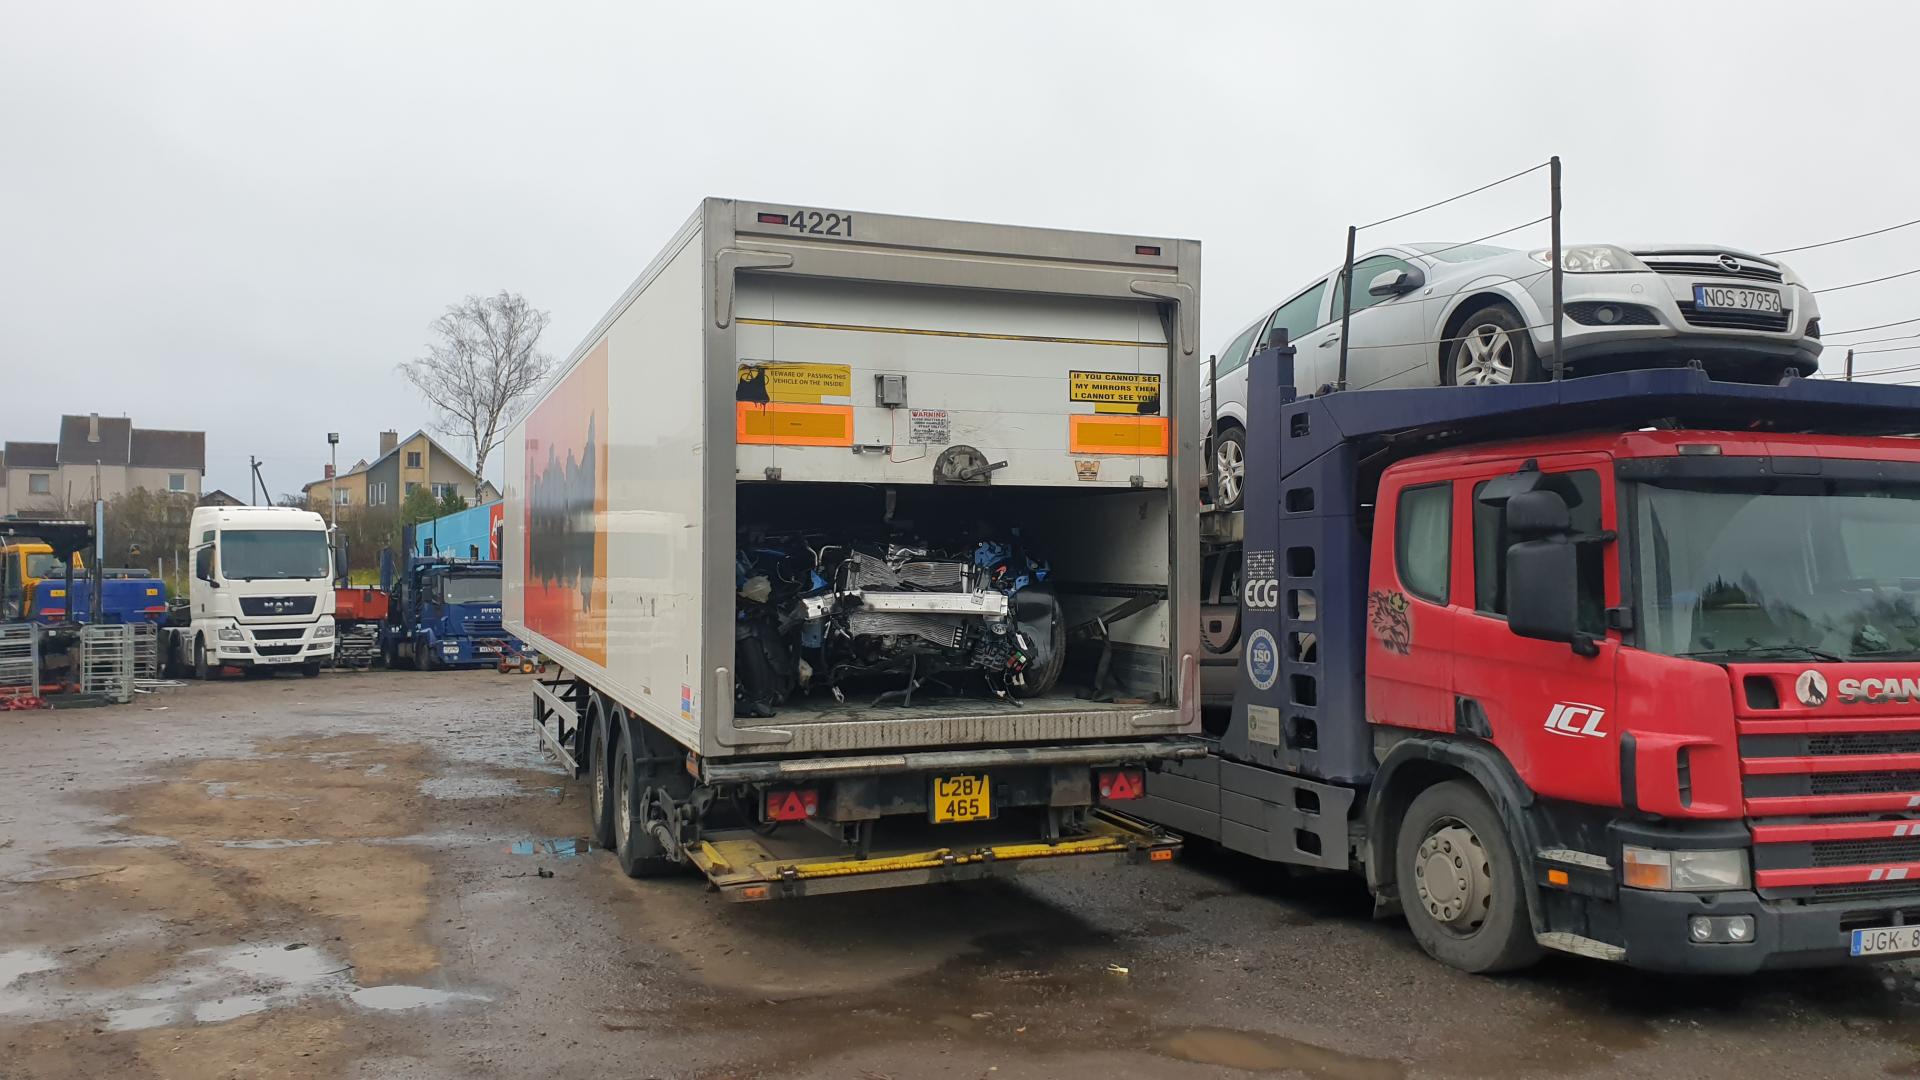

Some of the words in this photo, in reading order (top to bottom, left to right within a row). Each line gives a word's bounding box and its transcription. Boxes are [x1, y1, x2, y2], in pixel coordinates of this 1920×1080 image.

[790, 211, 852, 236] 4221
[1705, 289, 1735, 307] NOS
[1739, 291, 1779, 312] 37956
[1092, 384, 1131, 392] MIRRORS
[1245, 579, 1279, 608] ECG
[1253, 649, 1271, 663] ISO
[1544, 704, 1607, 738] ICL
[946, 799, 979, 817] 465
[1864, 931, 1900, 951] JGK
